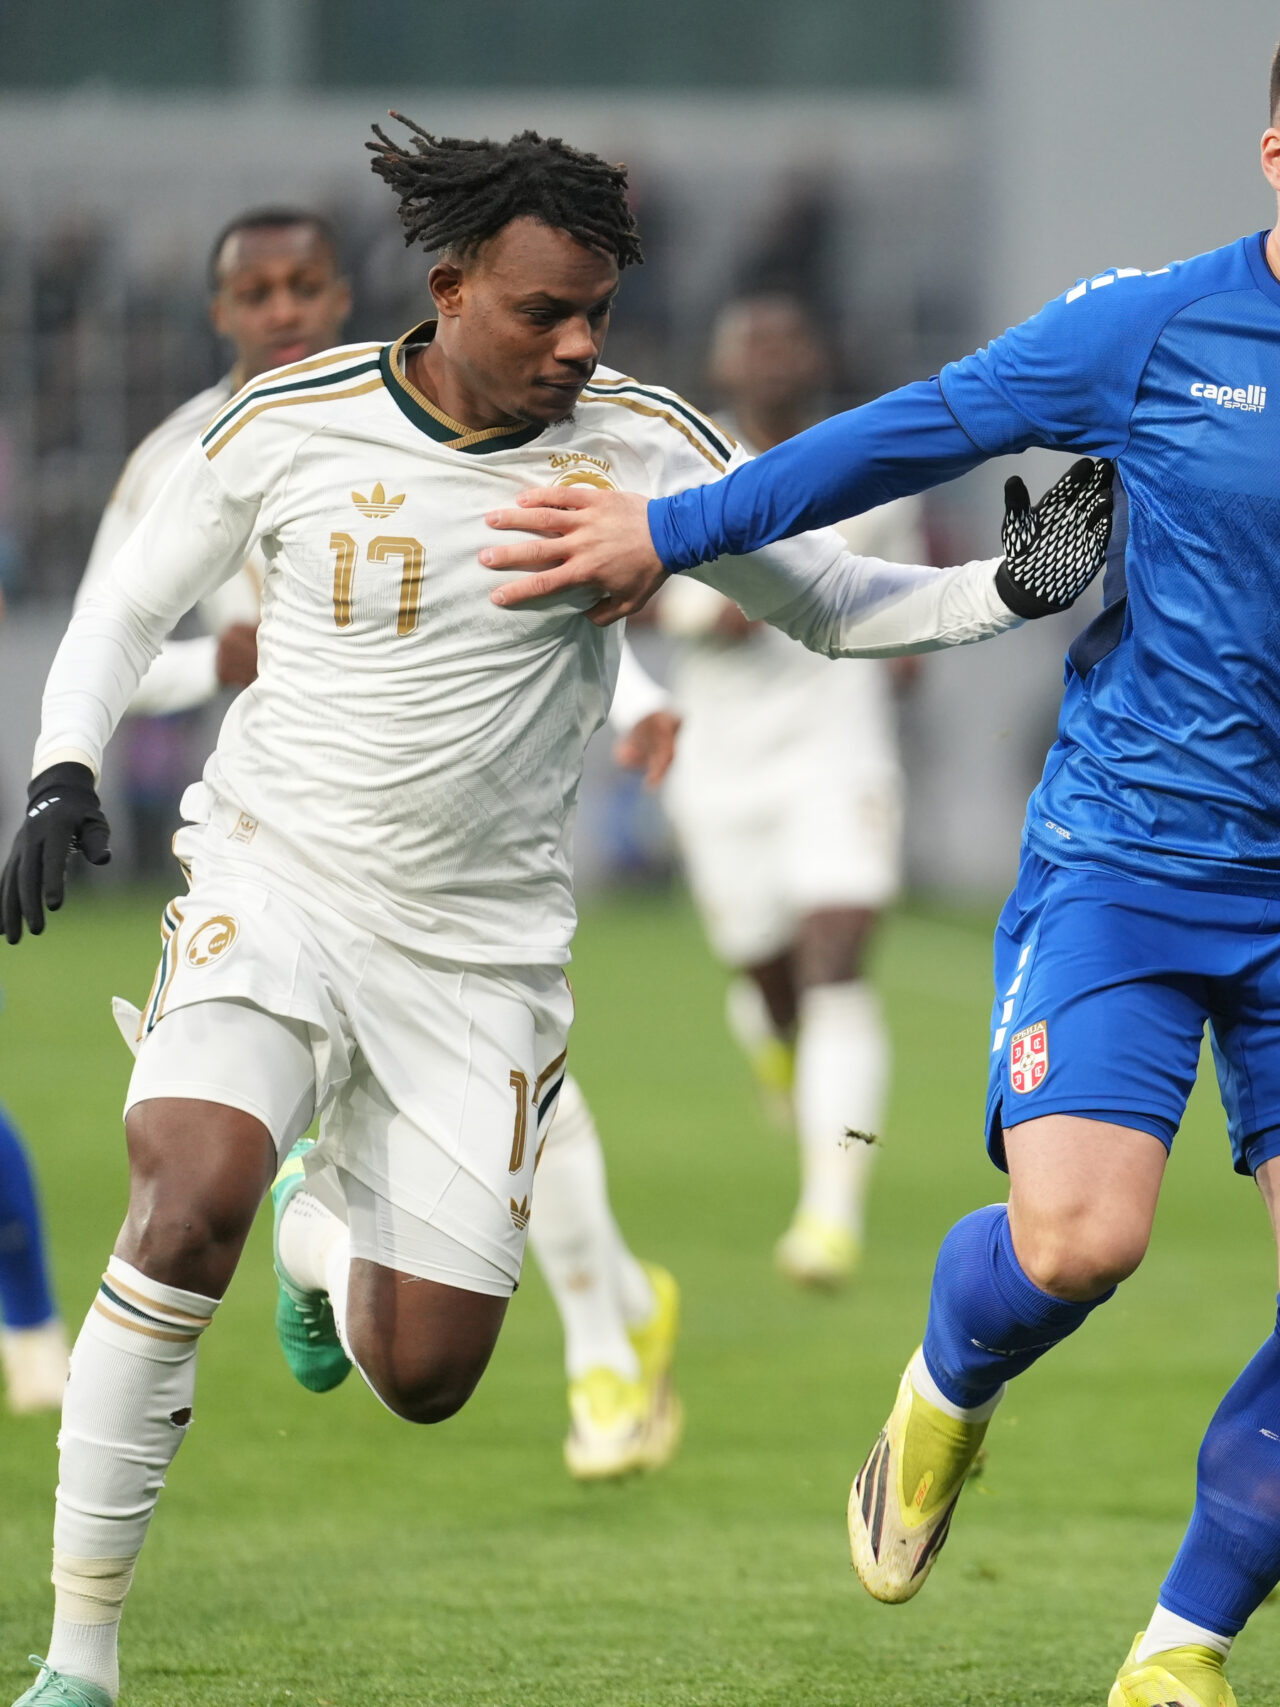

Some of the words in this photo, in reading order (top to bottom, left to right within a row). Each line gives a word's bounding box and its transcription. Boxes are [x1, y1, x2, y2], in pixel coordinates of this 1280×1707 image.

[1190, 382, 1267, 406] capelli
[1223, 401, 1265, 413] SPORT
[548, 453, 610, 473] السعودية
[329, 532, 427, 637] 17
[508, 1069, 539, 1175] 1
